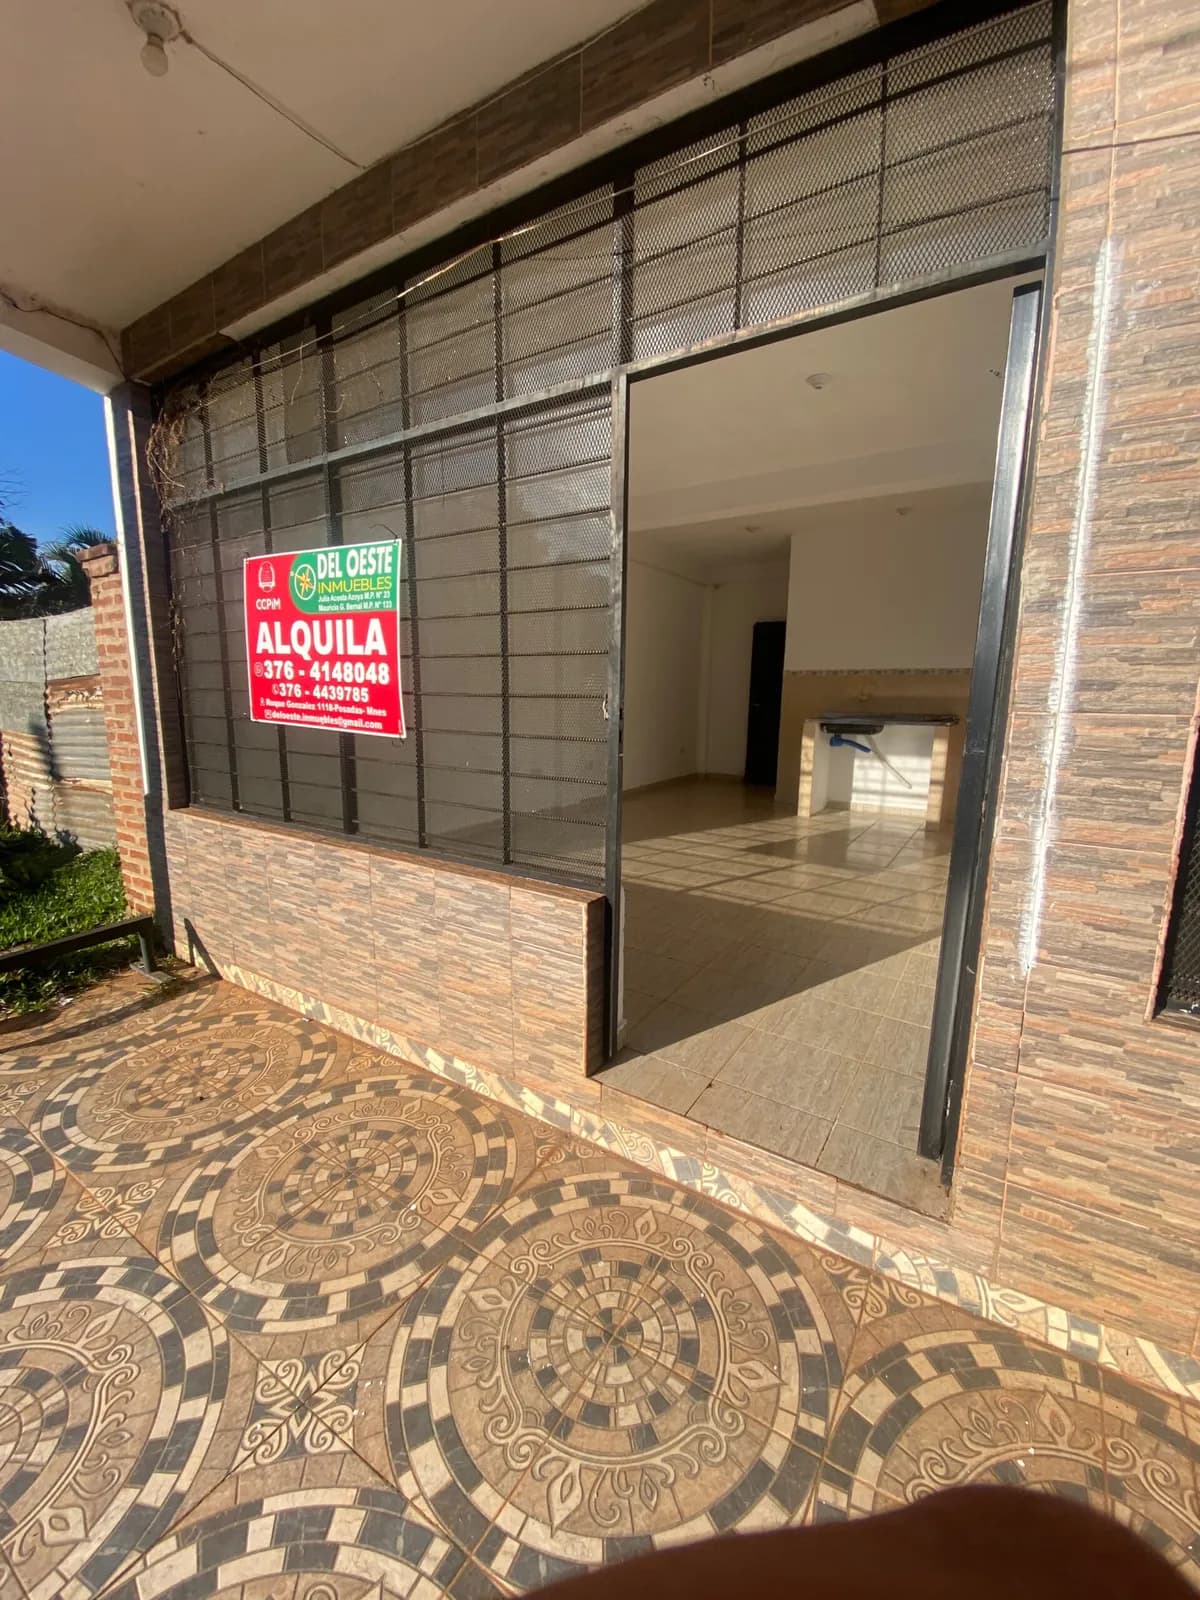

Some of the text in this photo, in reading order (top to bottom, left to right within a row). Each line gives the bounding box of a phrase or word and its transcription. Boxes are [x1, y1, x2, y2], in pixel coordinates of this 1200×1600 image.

[317, 545, 393, 579] DEL OESTE
[318, 576, 393, 594] INMUEBLES
[256, 618, 388, 660] ALQUILA
[263, 660, 294, 680] 376
[309, 661, 390, 685] 4148048
[279, 683, 302, 698] 376
[312, 685, 369, 702] 4439785
[271, 710, 383, 729] deloeste.inmuebles@gmail.com
